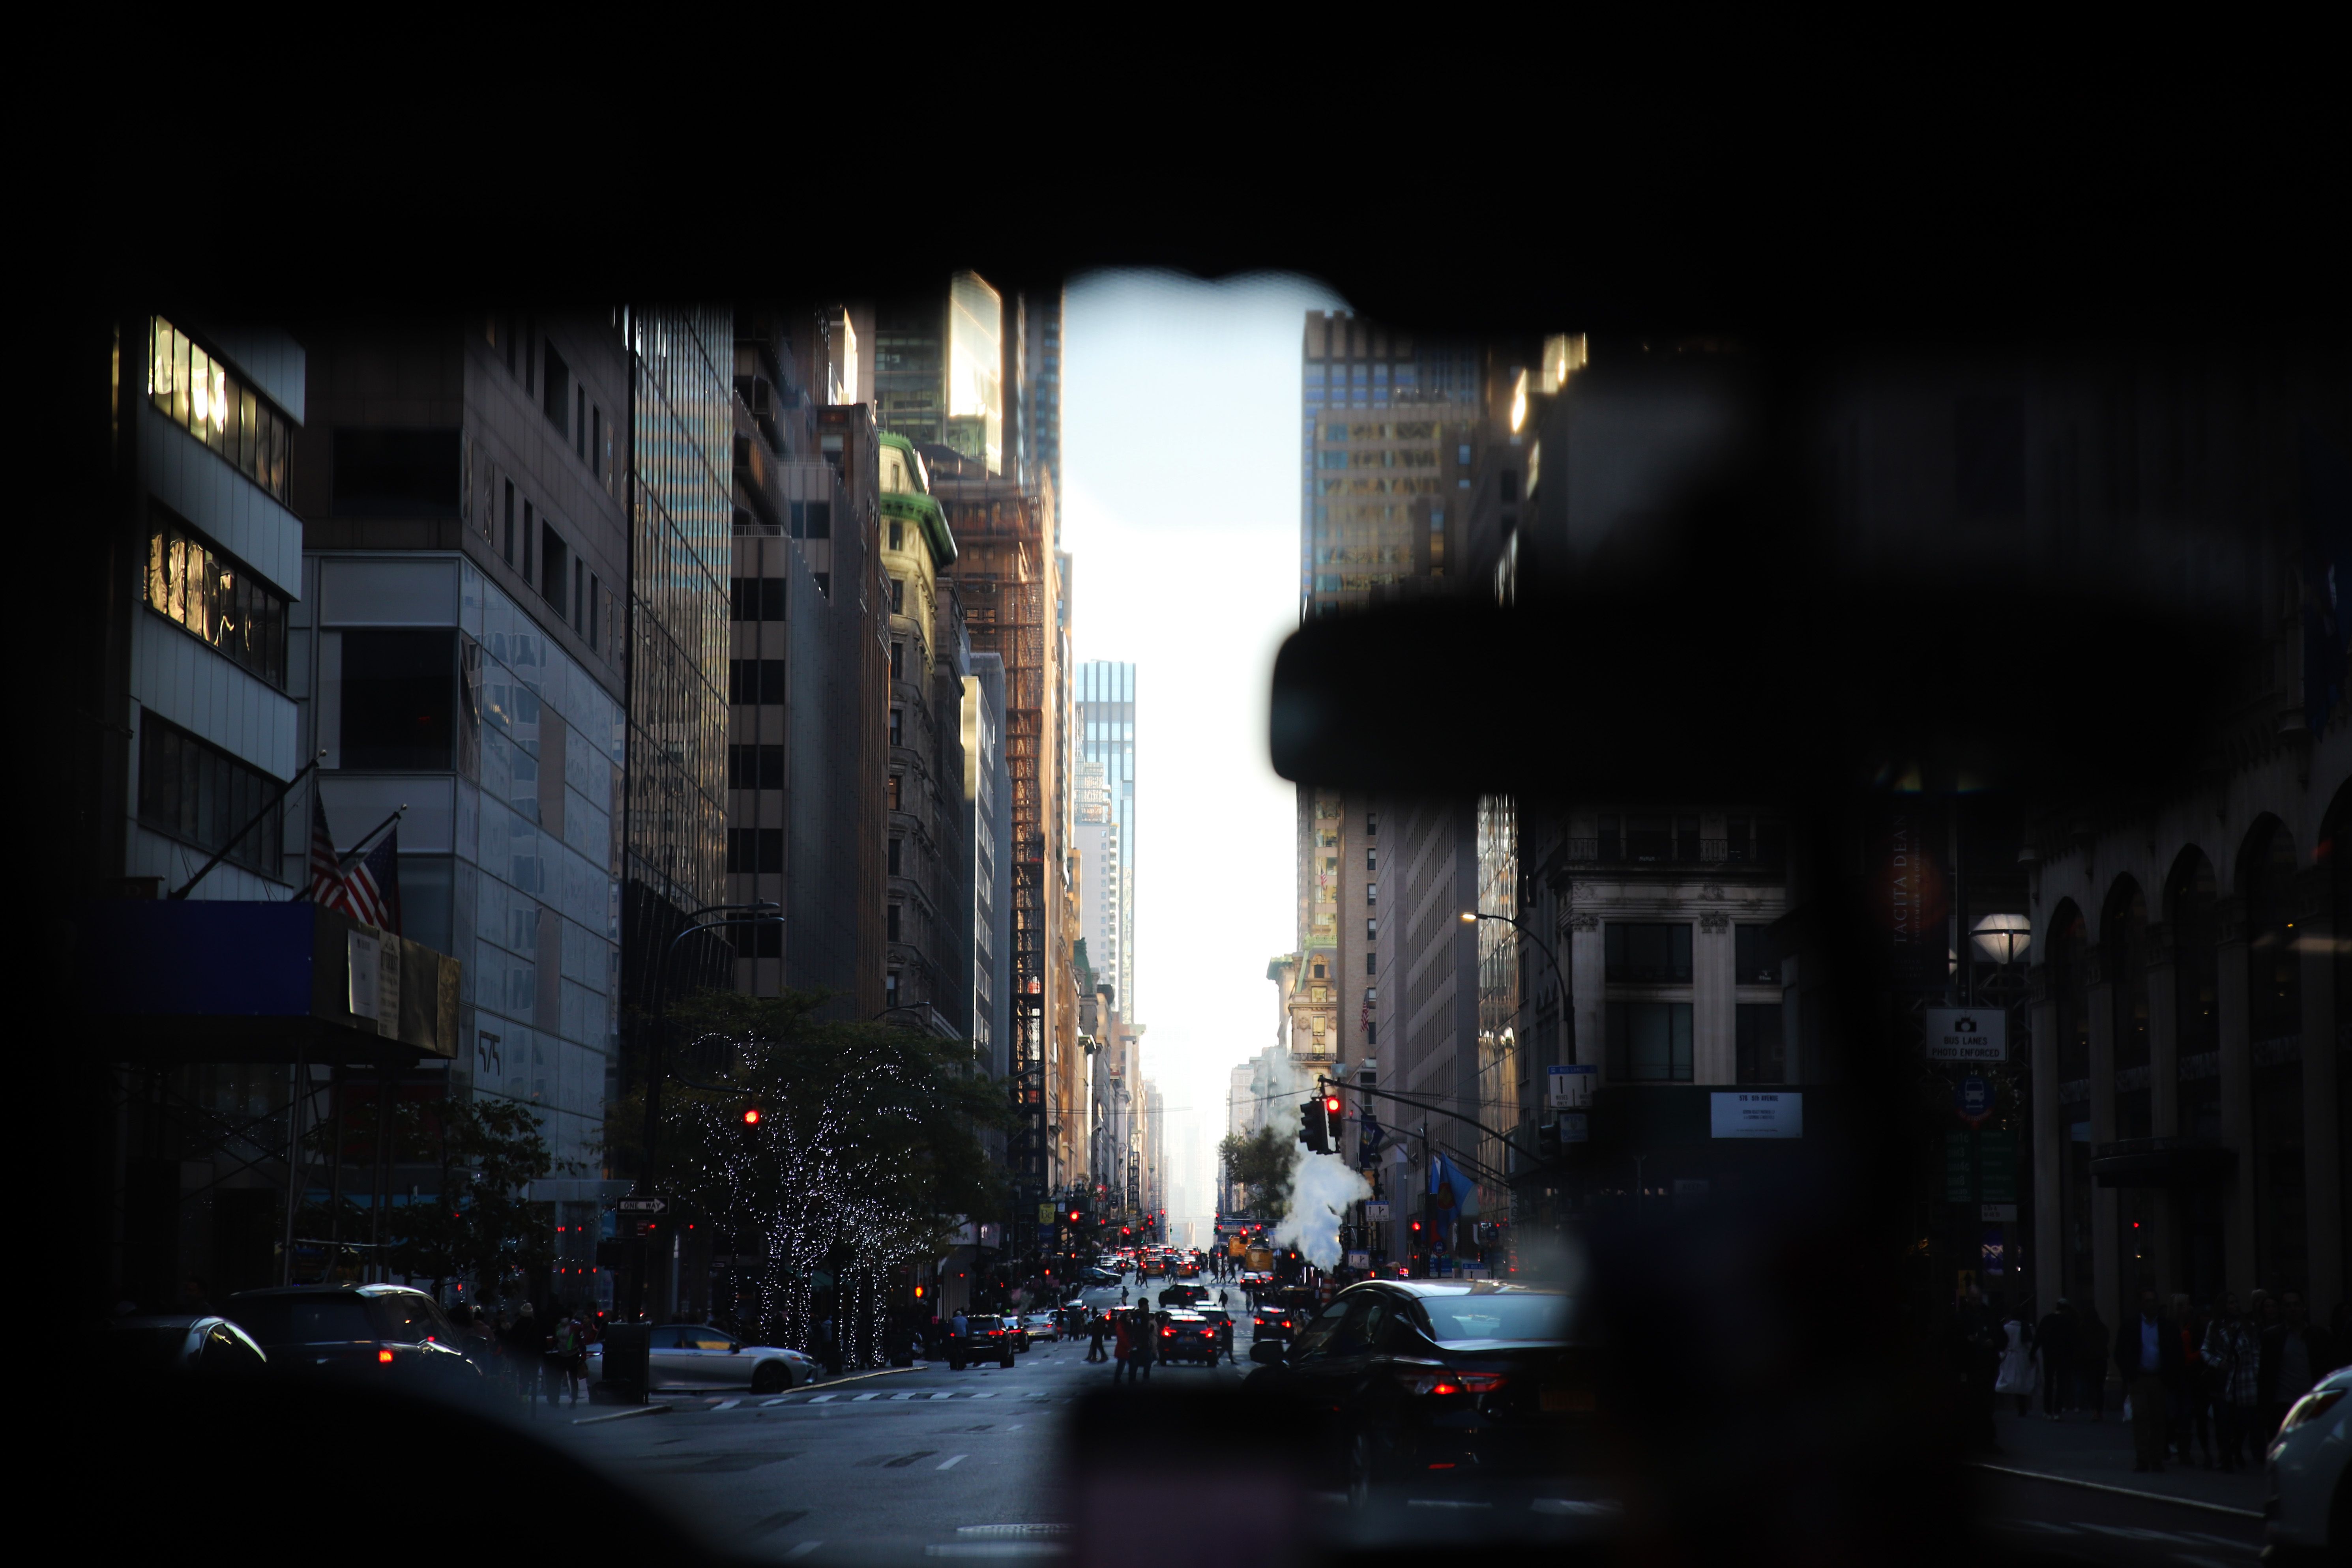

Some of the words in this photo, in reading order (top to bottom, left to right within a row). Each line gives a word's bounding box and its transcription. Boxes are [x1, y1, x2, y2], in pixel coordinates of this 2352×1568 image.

[1893, 814, 1907, 867] DEAN
[1893, 876, 1907, 946] TACITA
[479, 1030, 500, 1076] 575
[1932, 1048, 1957, 1057] PHOTO
[1961, 1048, 2000, 1057] ENFORCED
[1944, 1037, 1959, 1045] BUS
[1963, 1037, 1987, 1045] LANES
